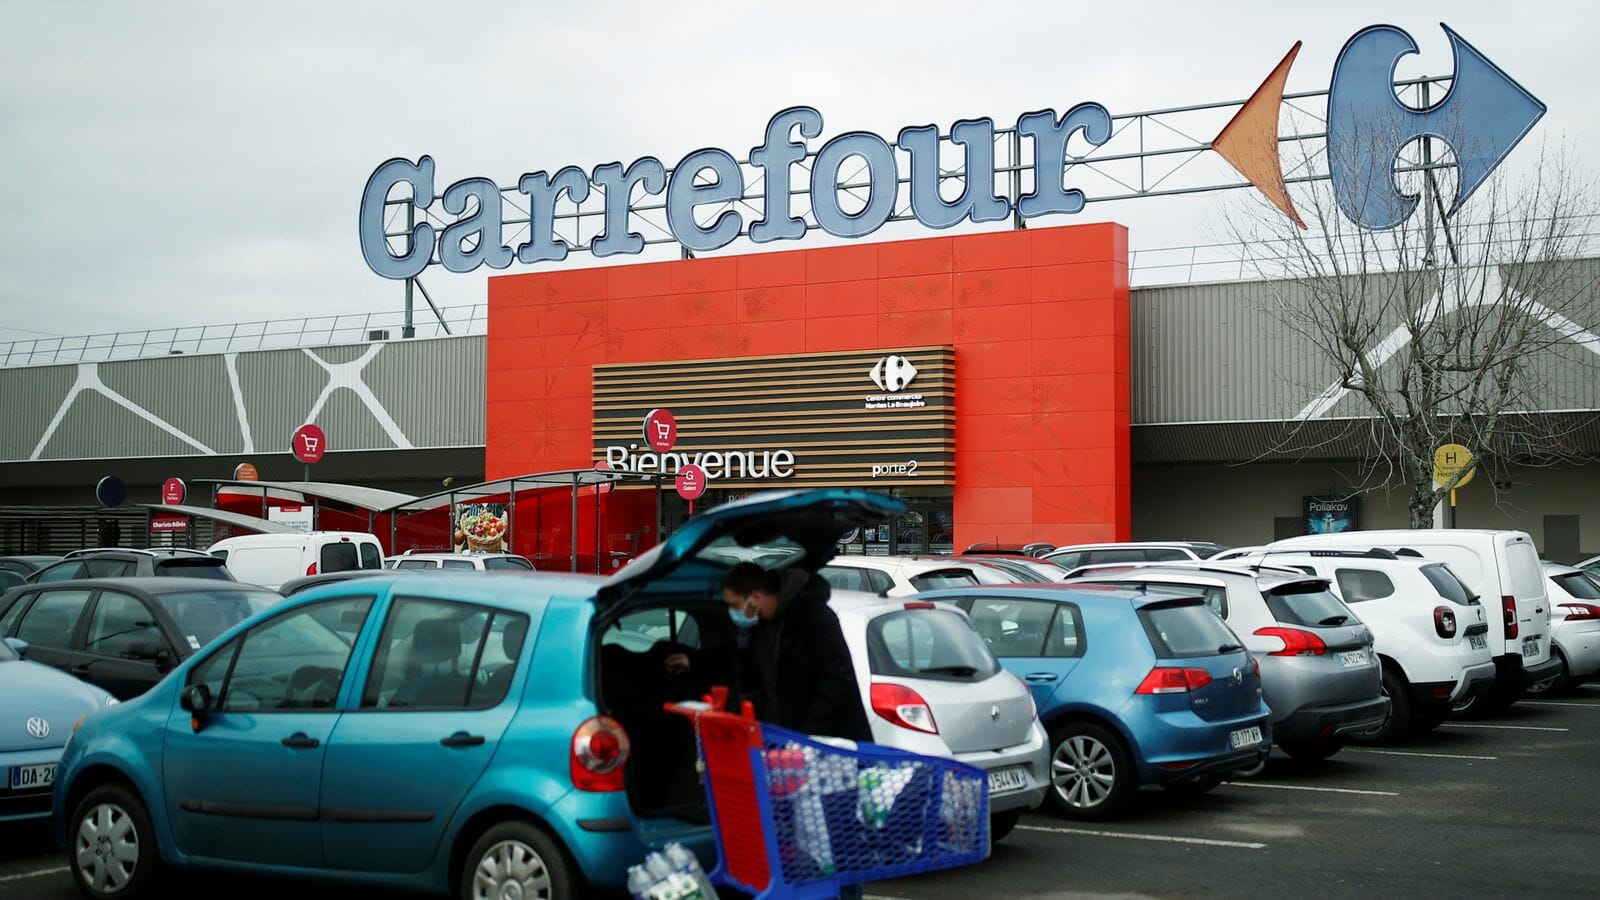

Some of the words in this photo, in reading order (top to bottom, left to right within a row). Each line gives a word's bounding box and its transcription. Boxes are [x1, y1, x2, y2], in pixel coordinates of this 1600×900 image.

[360, 101, 1112, 280] Carrefour
[1446, 452, 1456, 464] H
[686, 470, 694, 481] G
[170, 483, 176, 492] F
[1309, 502, 1348, 512] Poliakov
